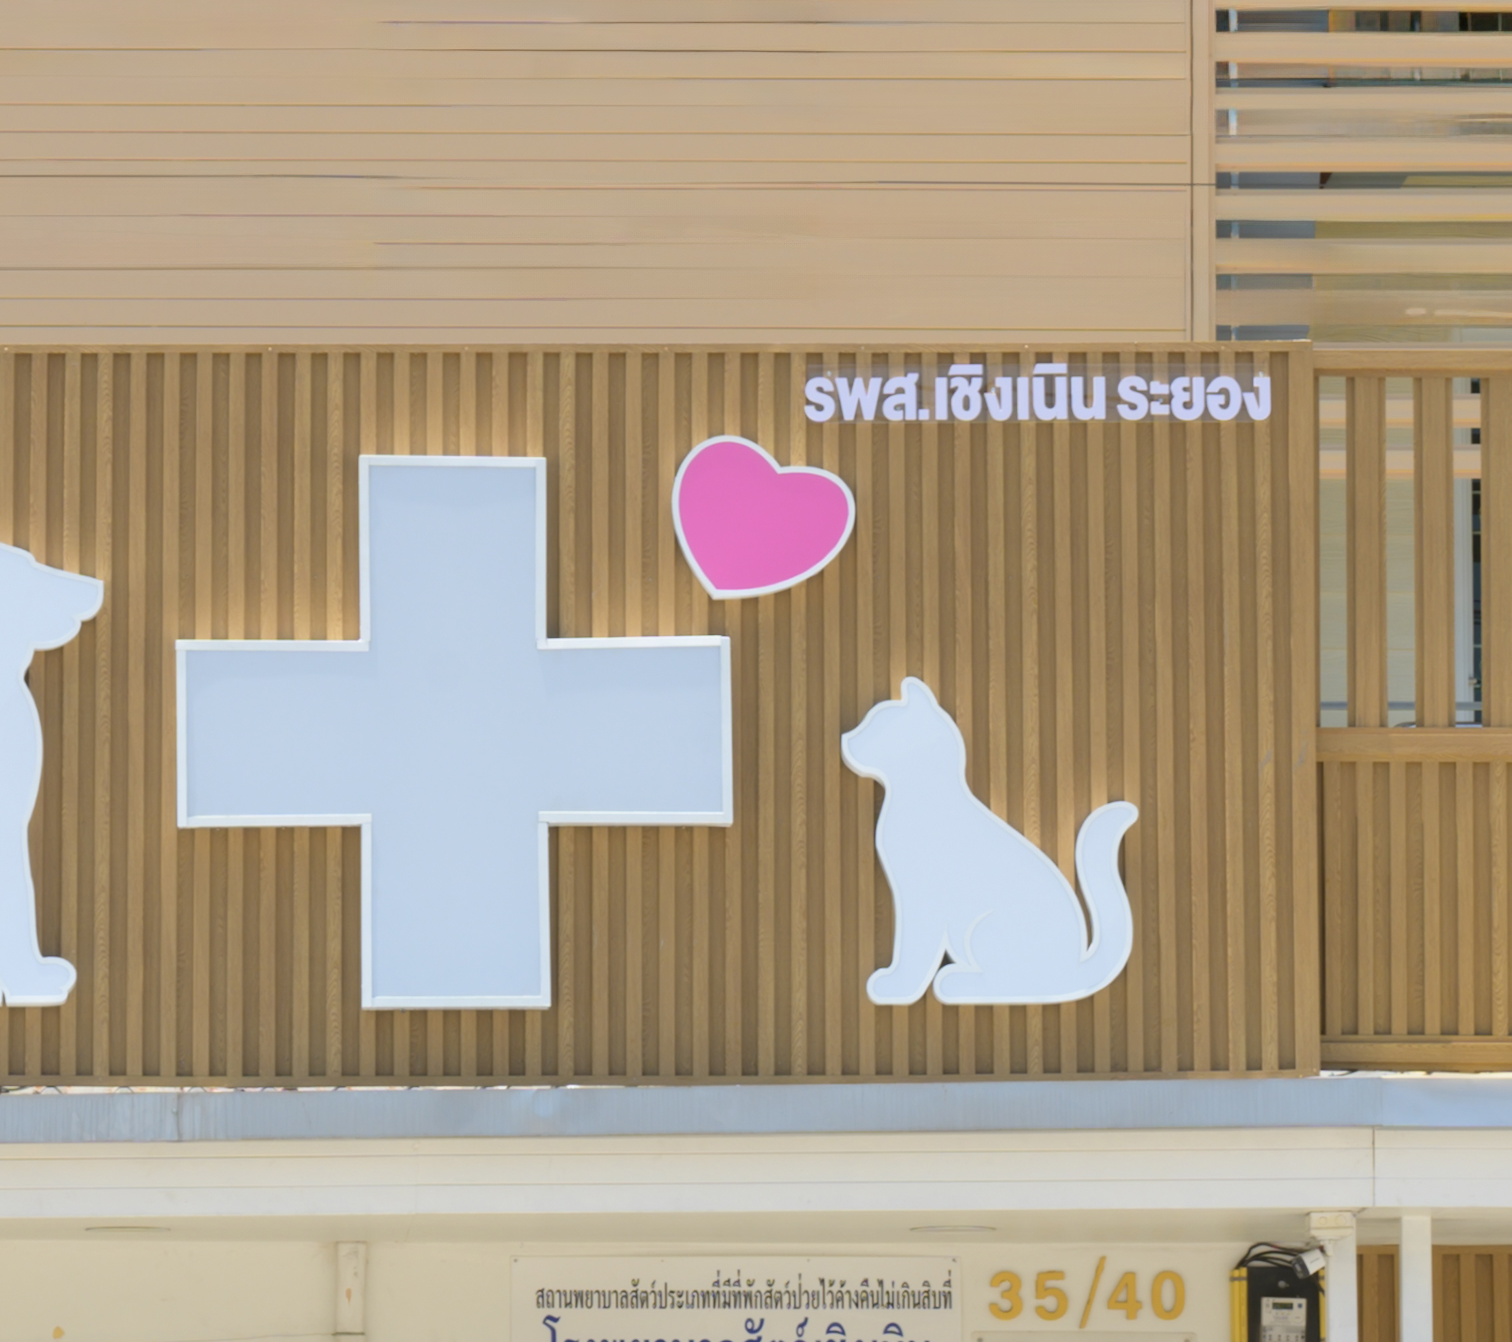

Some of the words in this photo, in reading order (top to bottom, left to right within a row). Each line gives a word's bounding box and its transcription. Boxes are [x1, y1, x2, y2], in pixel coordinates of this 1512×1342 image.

[804, 363, 1106, 422] รพส.เชิงเนิน
[1117, 373, 1271, 421] ระยอง
[988, 1256, 1185, 1328] 35/40
